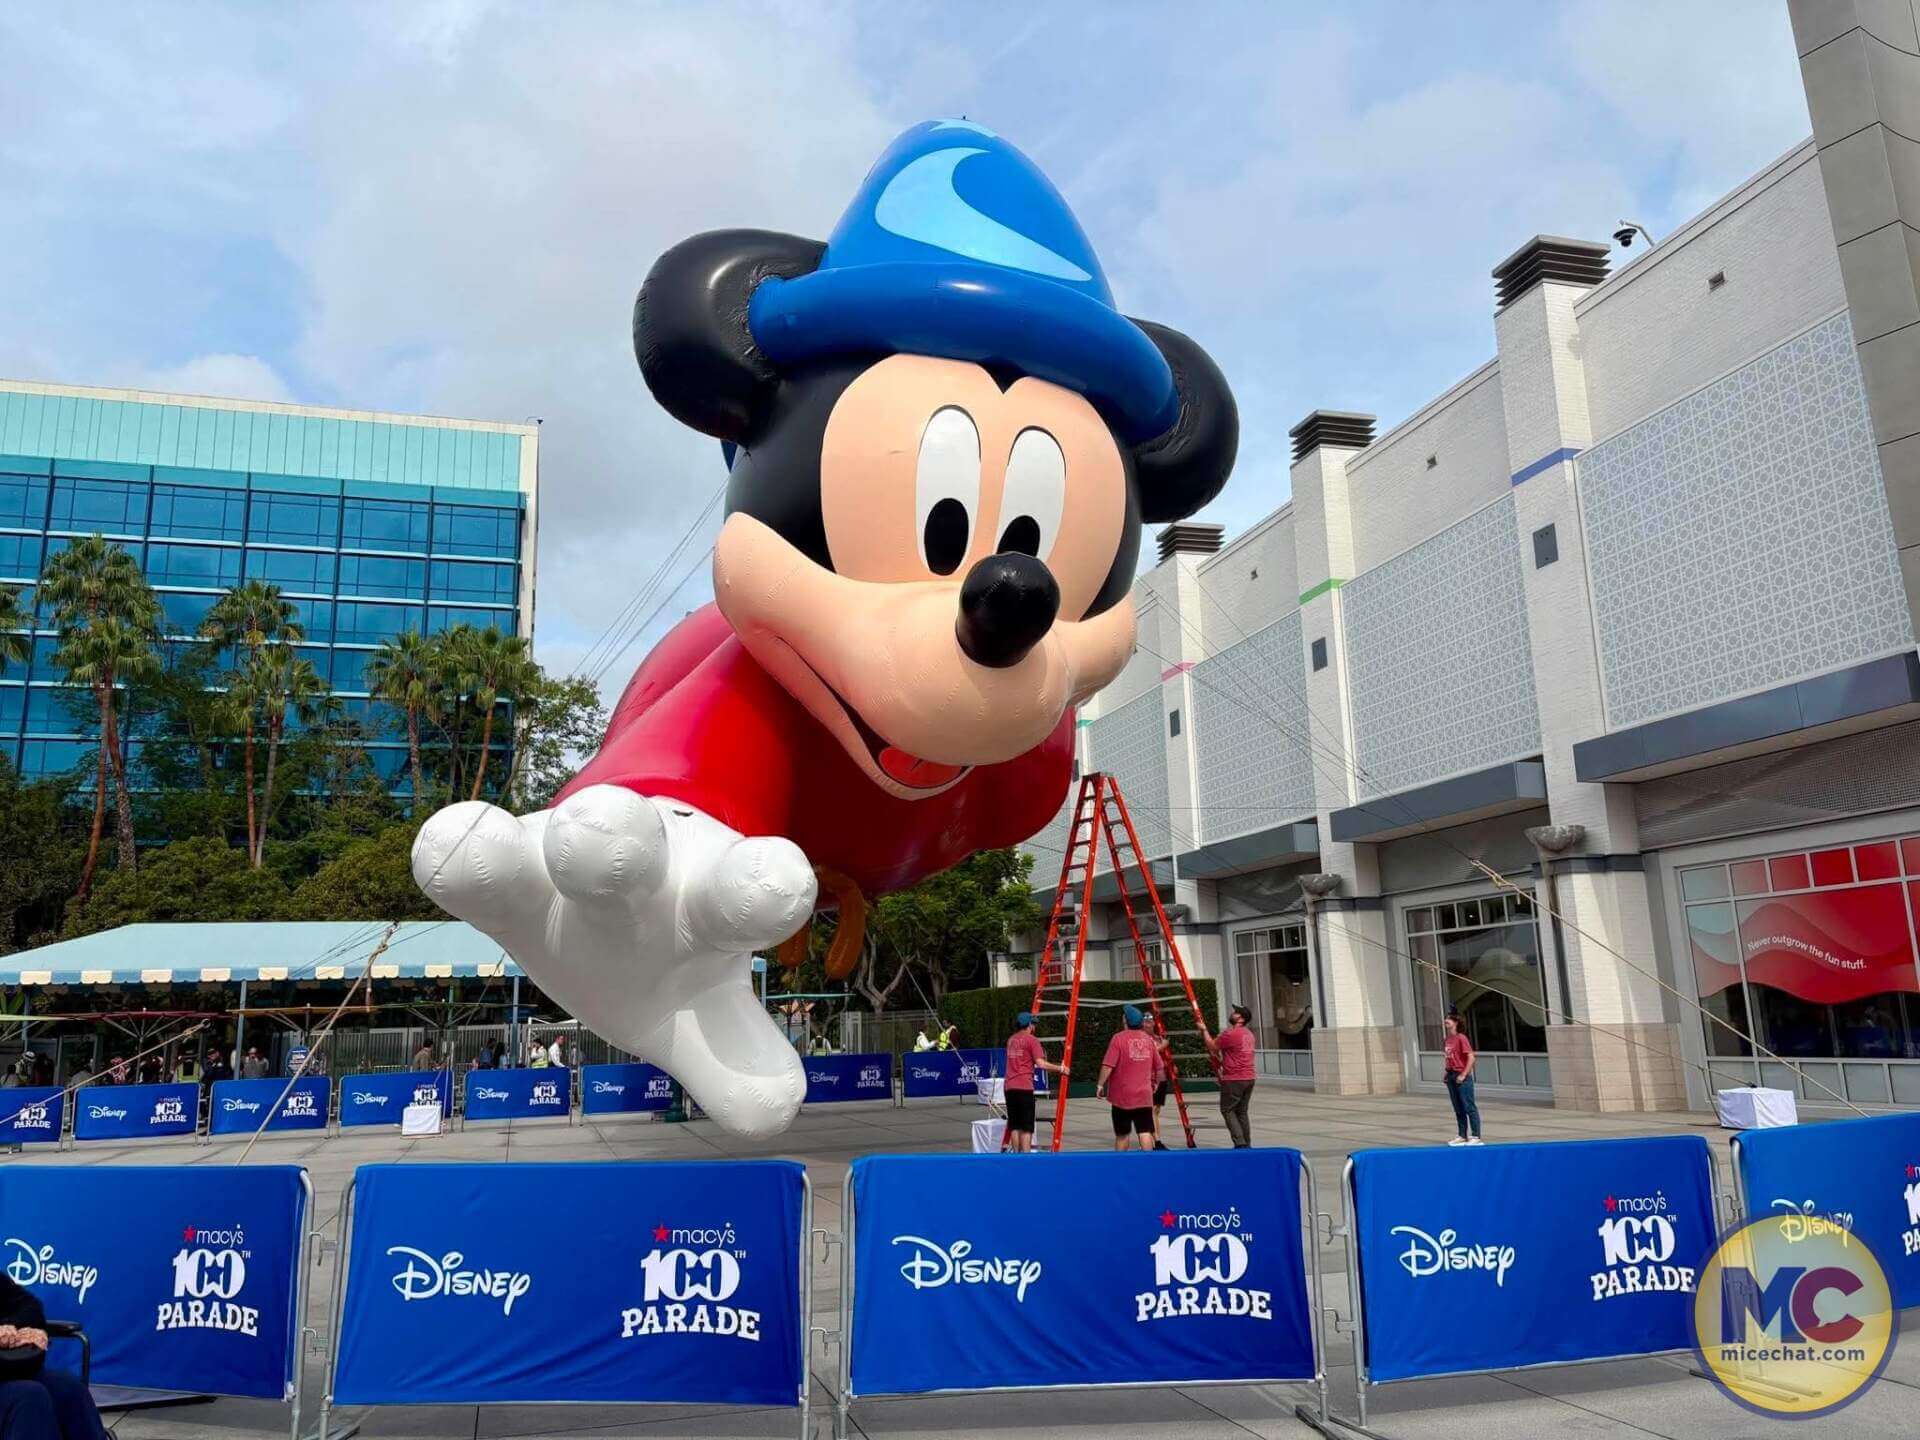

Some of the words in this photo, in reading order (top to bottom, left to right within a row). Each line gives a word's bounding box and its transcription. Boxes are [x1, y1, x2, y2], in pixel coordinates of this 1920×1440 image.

[1748, 937, 1771, 951] Never
[1772, 935, 1808, 951] outgrow
[1809, 944, 1824, 958] the
[1825, 951, 1840, 966] fun
[14, 1120, 51, 1129] PARADE
[150, 1114, 187, 1124] PARADE
[282, 1108, 318, 1117] PARADE
[1179, 1207, 1240, 1231] macy's
[1619, 1191, 1666, 1214] macy's
[196, 1224, 243, 1248] macy's
[672, 1223, 735, 1248] macy's
[4, 1239, 97, 1304] Disney
[892, 1236, 1041, 1302] Disney
[1391, 1226, 1515, 1286] Disney
[387, 1246, 530, 1316] Disney
[1591, 1265, 1697, 1301] PARADE
[156, 1300, 258, 1337] PARADE
[1136, 1284, 1272, 1322] PARADE
[622, 1304, 760, 1341] PARADE
